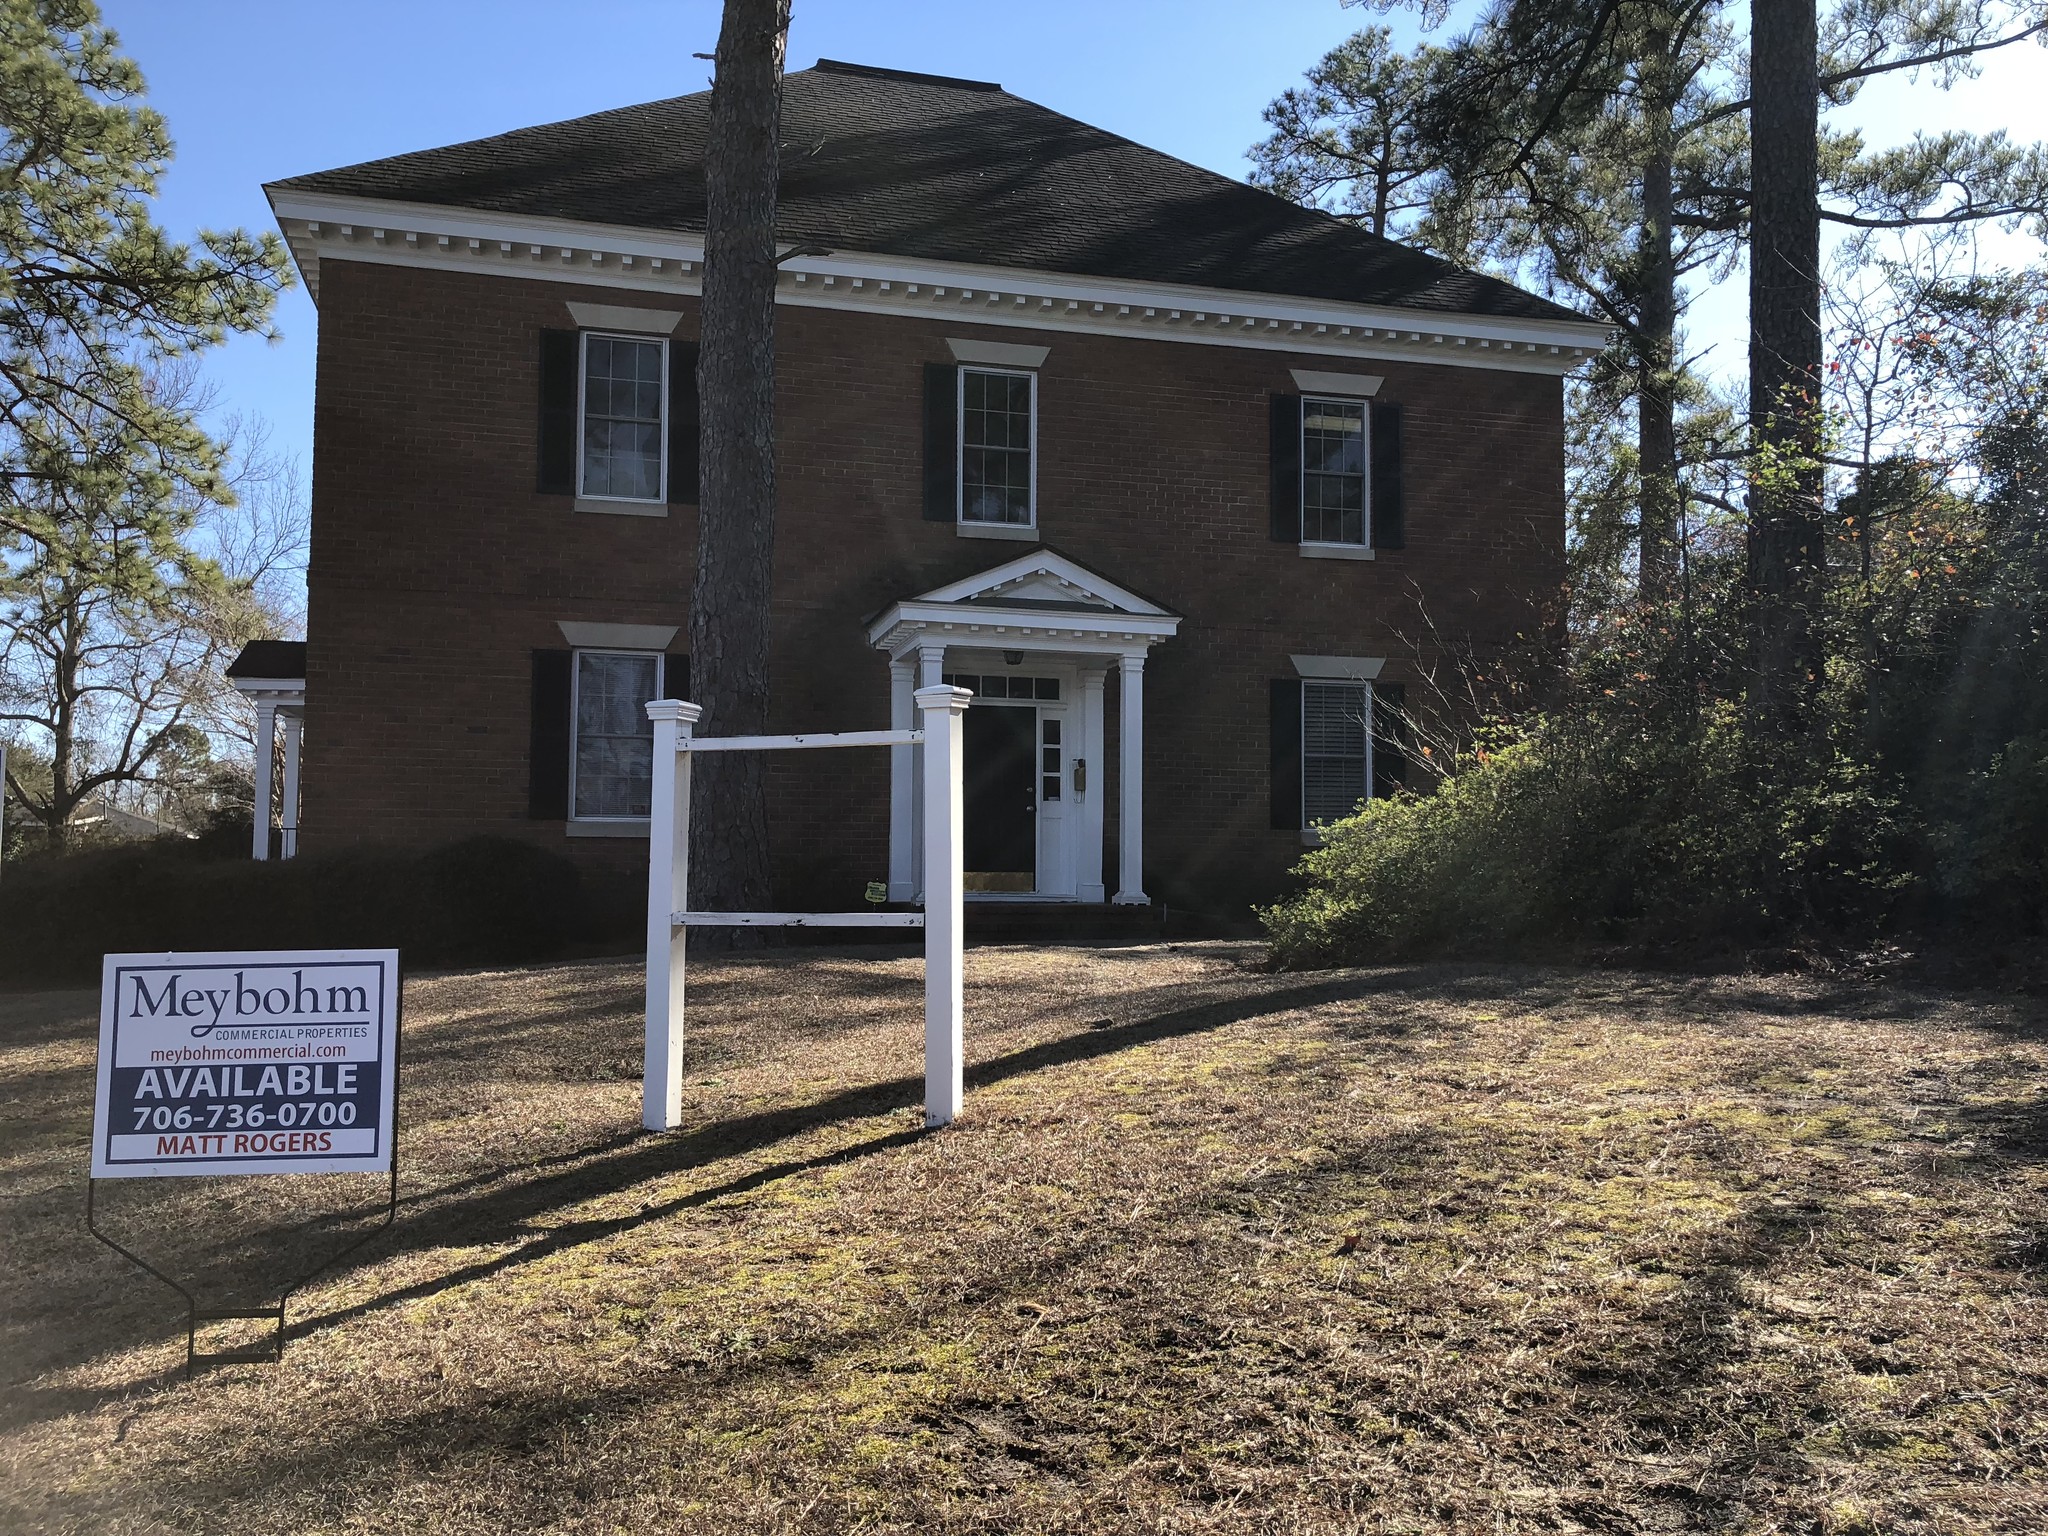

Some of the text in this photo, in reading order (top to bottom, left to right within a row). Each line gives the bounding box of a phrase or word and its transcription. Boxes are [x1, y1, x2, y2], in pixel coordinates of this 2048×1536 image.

[129, 970, 370, 1038] Meybohm
[215, 1027, 368, 1041] COMMERCIAL PROPERTIES
[150, 1042, 346, 1064] meybohmcommercial.com
[134, 1064, 358, 1100] AVAILABLE
[132, 1101, 357, 1131] 706-736-0700
[156, 1131, 332, 1155] MATT ROGERS
